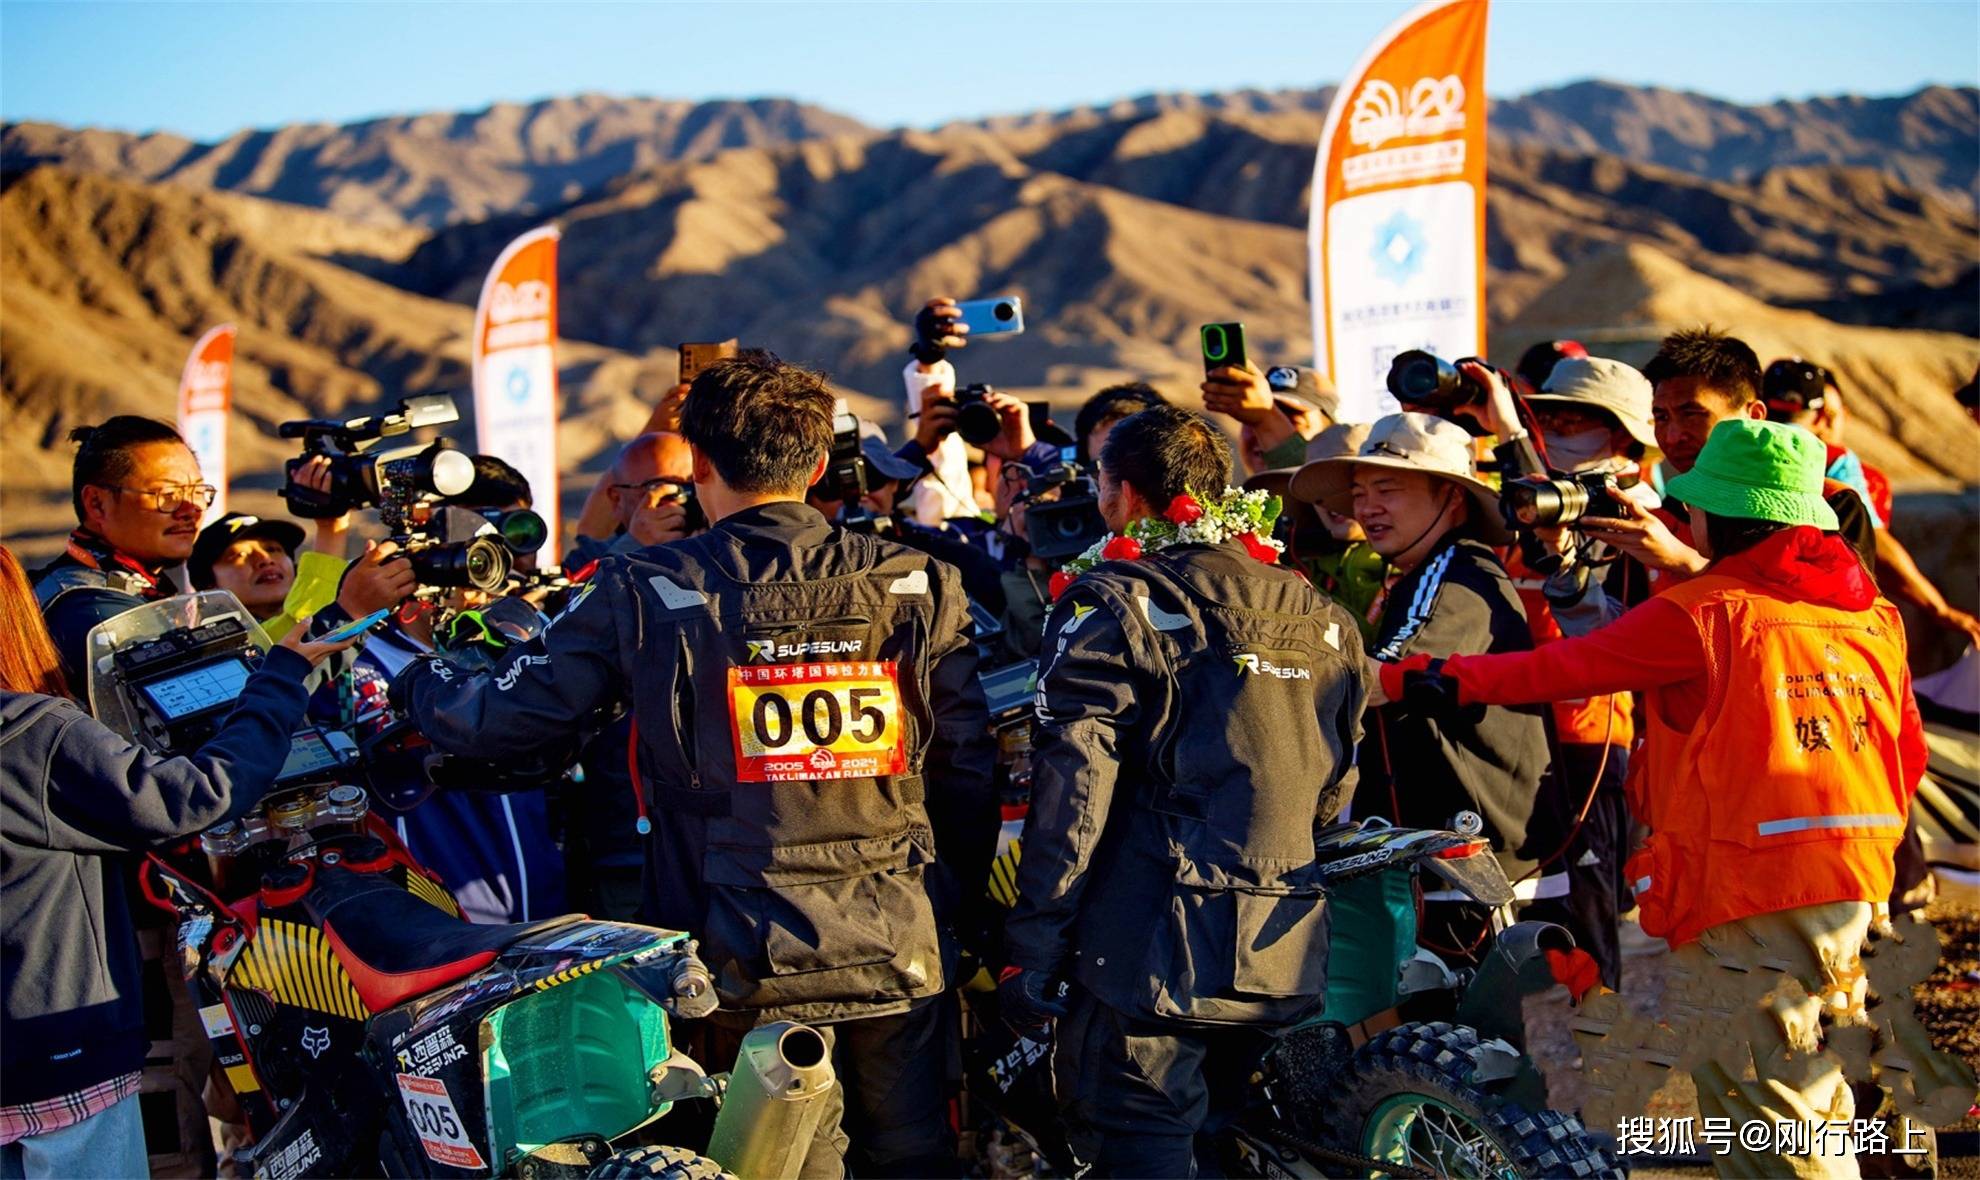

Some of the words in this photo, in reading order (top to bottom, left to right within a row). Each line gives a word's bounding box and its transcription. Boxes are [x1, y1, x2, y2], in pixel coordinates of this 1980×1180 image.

[777, 639, 862, 658] SUPESUNR
[739, 663, 884, 681] 中国环塔国际拉力赛
[752, 688, 886, 748] 005
[764, 761, 804, 771] 2005
[841, 757, 877, 769] 2024
[765, 769, 842, 782] TAKLIMAKAN
[843, 767, 877, 780] RALLY
[409, 1098, 460, 1140] 005
